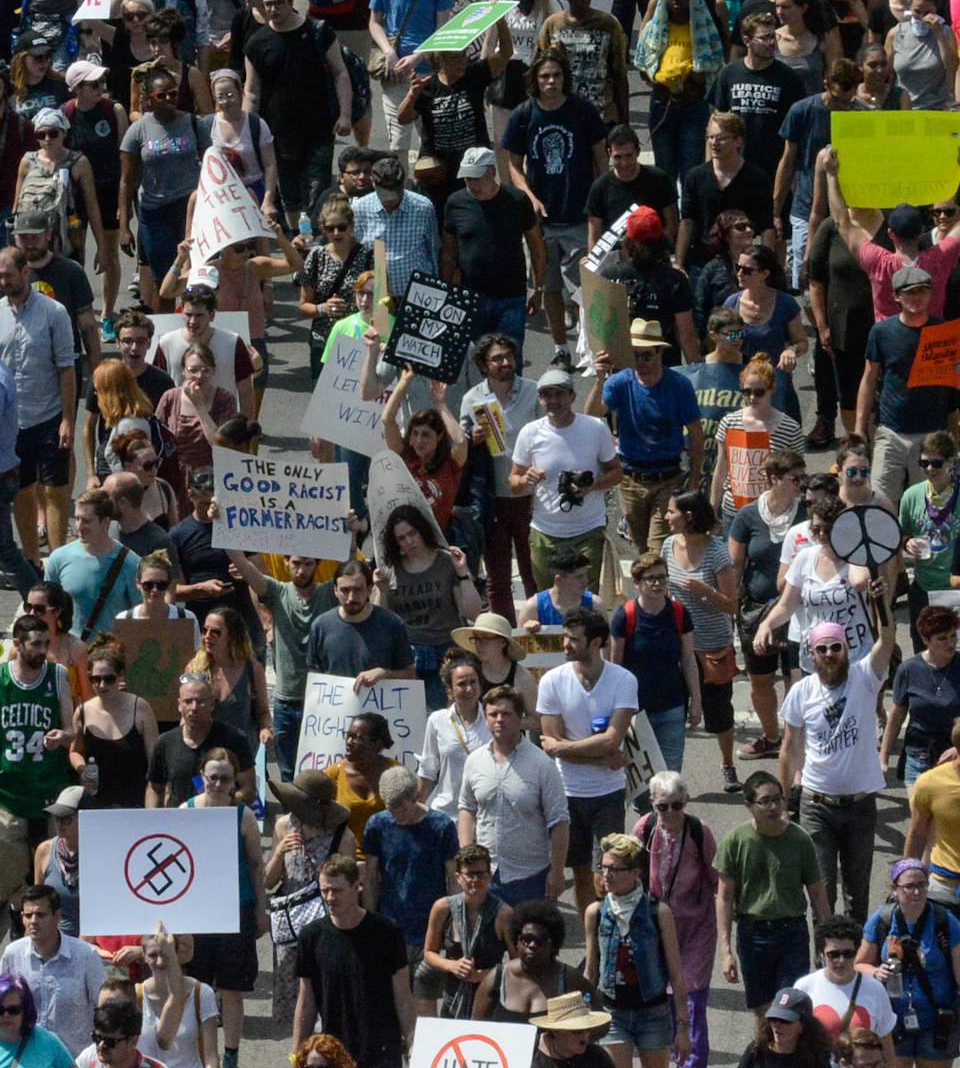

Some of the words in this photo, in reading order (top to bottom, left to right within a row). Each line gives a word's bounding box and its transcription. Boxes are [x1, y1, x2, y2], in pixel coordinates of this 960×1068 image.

[731, 83, 781, 93] JUSTICE
[731, 91, 781, 102] LEAGUE
[741, 99, 765, 108] NYC
[204, 183, 242, 208] THE
[413, 291, 442, 311] NOT
[443, 305, 461, 322] ON
[420, 318, 441, 334] MY
[336, 346, 363, 372] WE
[401, 337, 440, 359] WATCH
[332, 378, 360, 393] LET
[339, 403, 383, 430] WIN
[730, 450, 769, 465] BLACK
[240, 458, 276, 478] THE
[283, 464, 324, 483] ONLY
[730, 465, 767, 479] LIVES
[223, 472, 281, 494] GOOD
[288, 482, 346, 503] RACIST
[260, 496, 277, 511] IS
[284, 499, 296, 511] A
[225, 506, 291, 531] FORMER
[295, 514, 350, 533] RACIST
[803, 585, 858, 609] BLACK
[312, 681, 345, 707] THE
[362, 686, 409, 711] ALT
[1, 702, 52, 730] CELTICS
[5, 729, 45, 763] 34
[780, 993, 788, 1005] B
